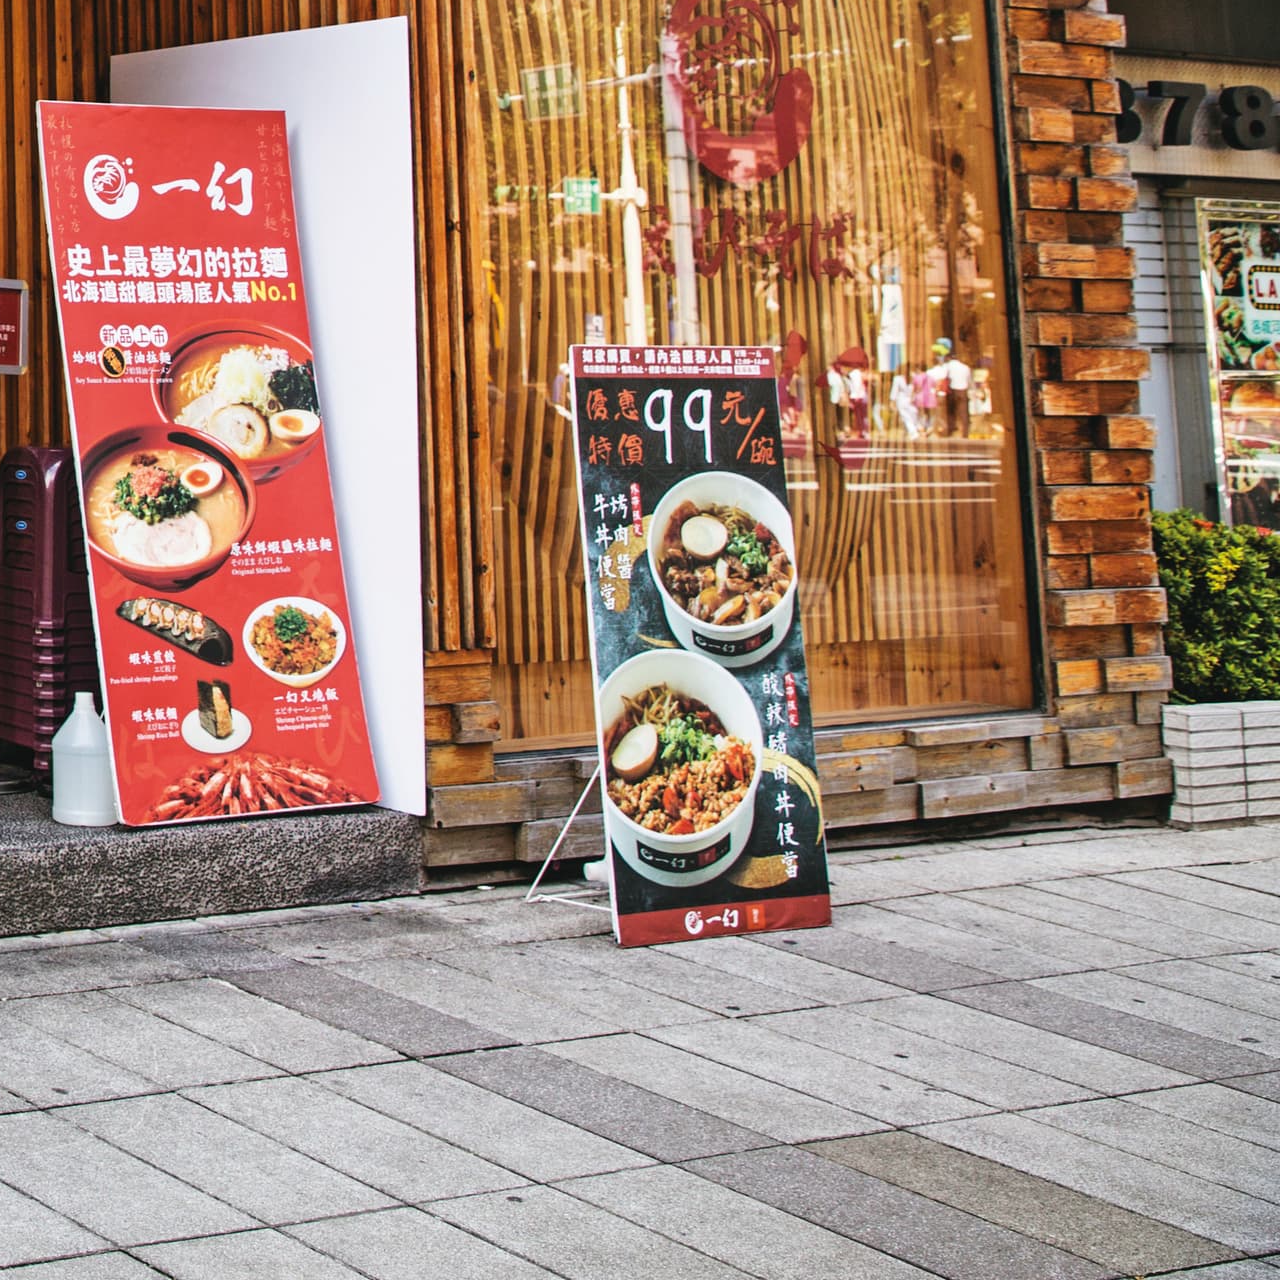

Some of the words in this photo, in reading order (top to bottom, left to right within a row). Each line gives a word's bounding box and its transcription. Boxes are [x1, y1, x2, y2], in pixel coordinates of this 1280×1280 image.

[151, 161, 254, 216] 一幻
[67, 243, 289, 278] 史上最夢幻的拉麵
[101, 326, 167, 345] 新品上市
[586, 388, 639, 421] 優惠
[644, 388, 713, 465] 99
[589, 433, 644, 467] 特價
[609, 493, 633, 580] 烤肉醬
